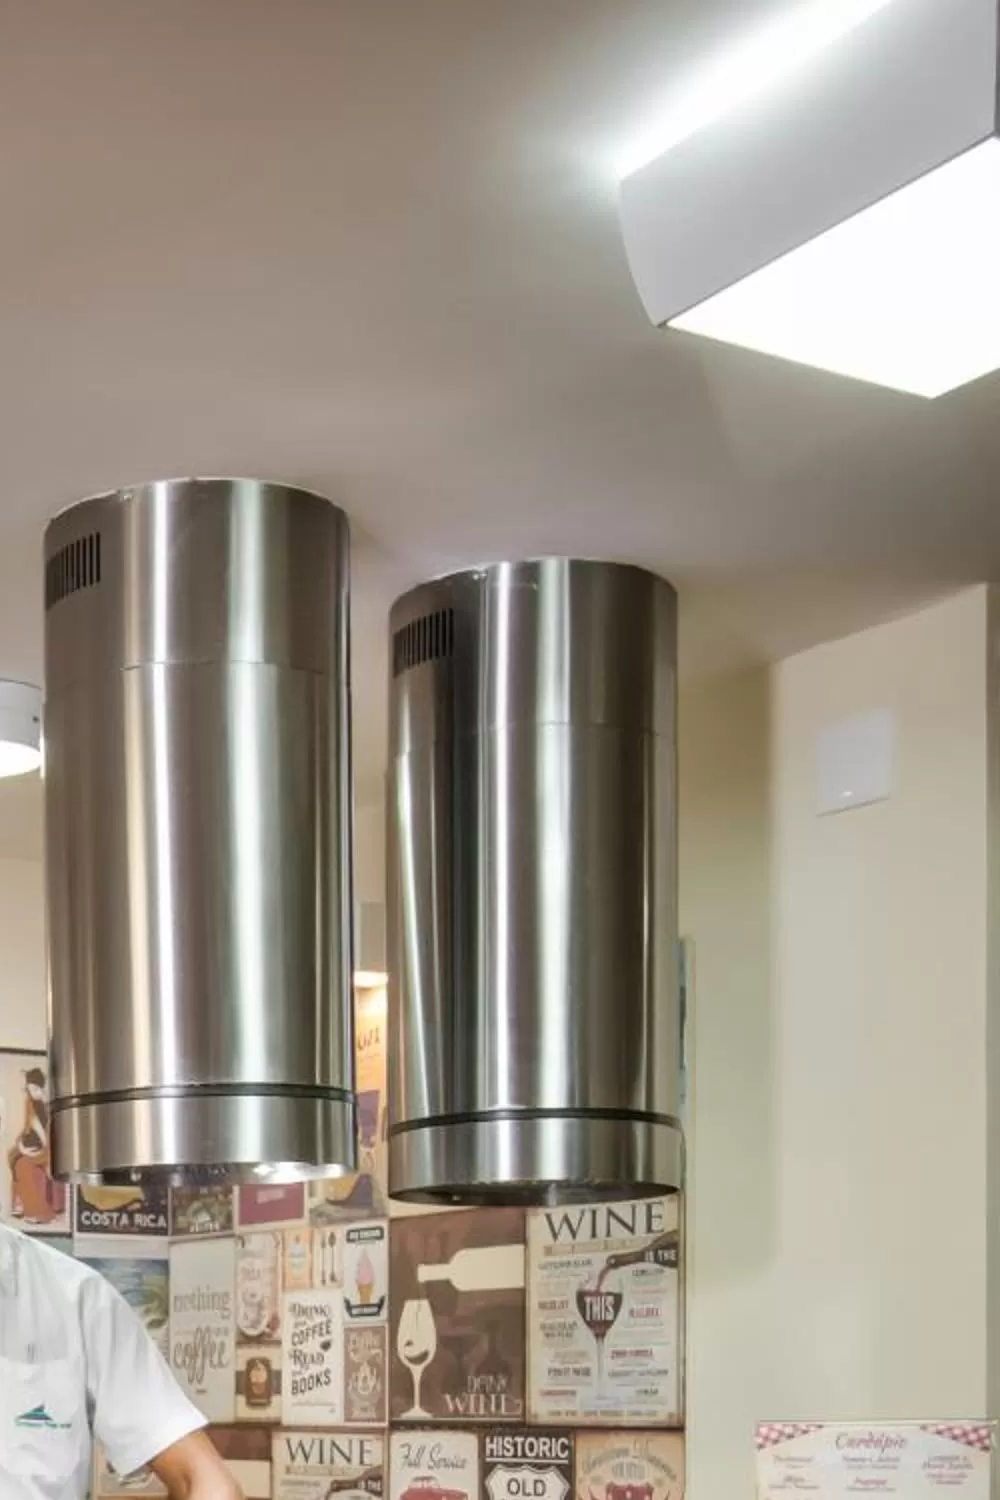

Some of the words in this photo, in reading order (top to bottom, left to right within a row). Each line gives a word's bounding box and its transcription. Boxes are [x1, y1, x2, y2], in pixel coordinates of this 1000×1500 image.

[81, 1210, 130, 1227] COSTA
[134, 1212, 168, 1228] RICA
[544, 1201, 665, 1243] WINE
[583, 1294, 616, 1321] THIS
[291, 1318, 332, 1347] COFFEE
[291, 1367, 332, 1396] BOOKS
[284, 1437, 373, 1467] WINE
[399, 1442, 427, 1470] Full
[485, 1436, 569, 1459] HISTORIC
[506, 1477, 547, 1498] OLD
